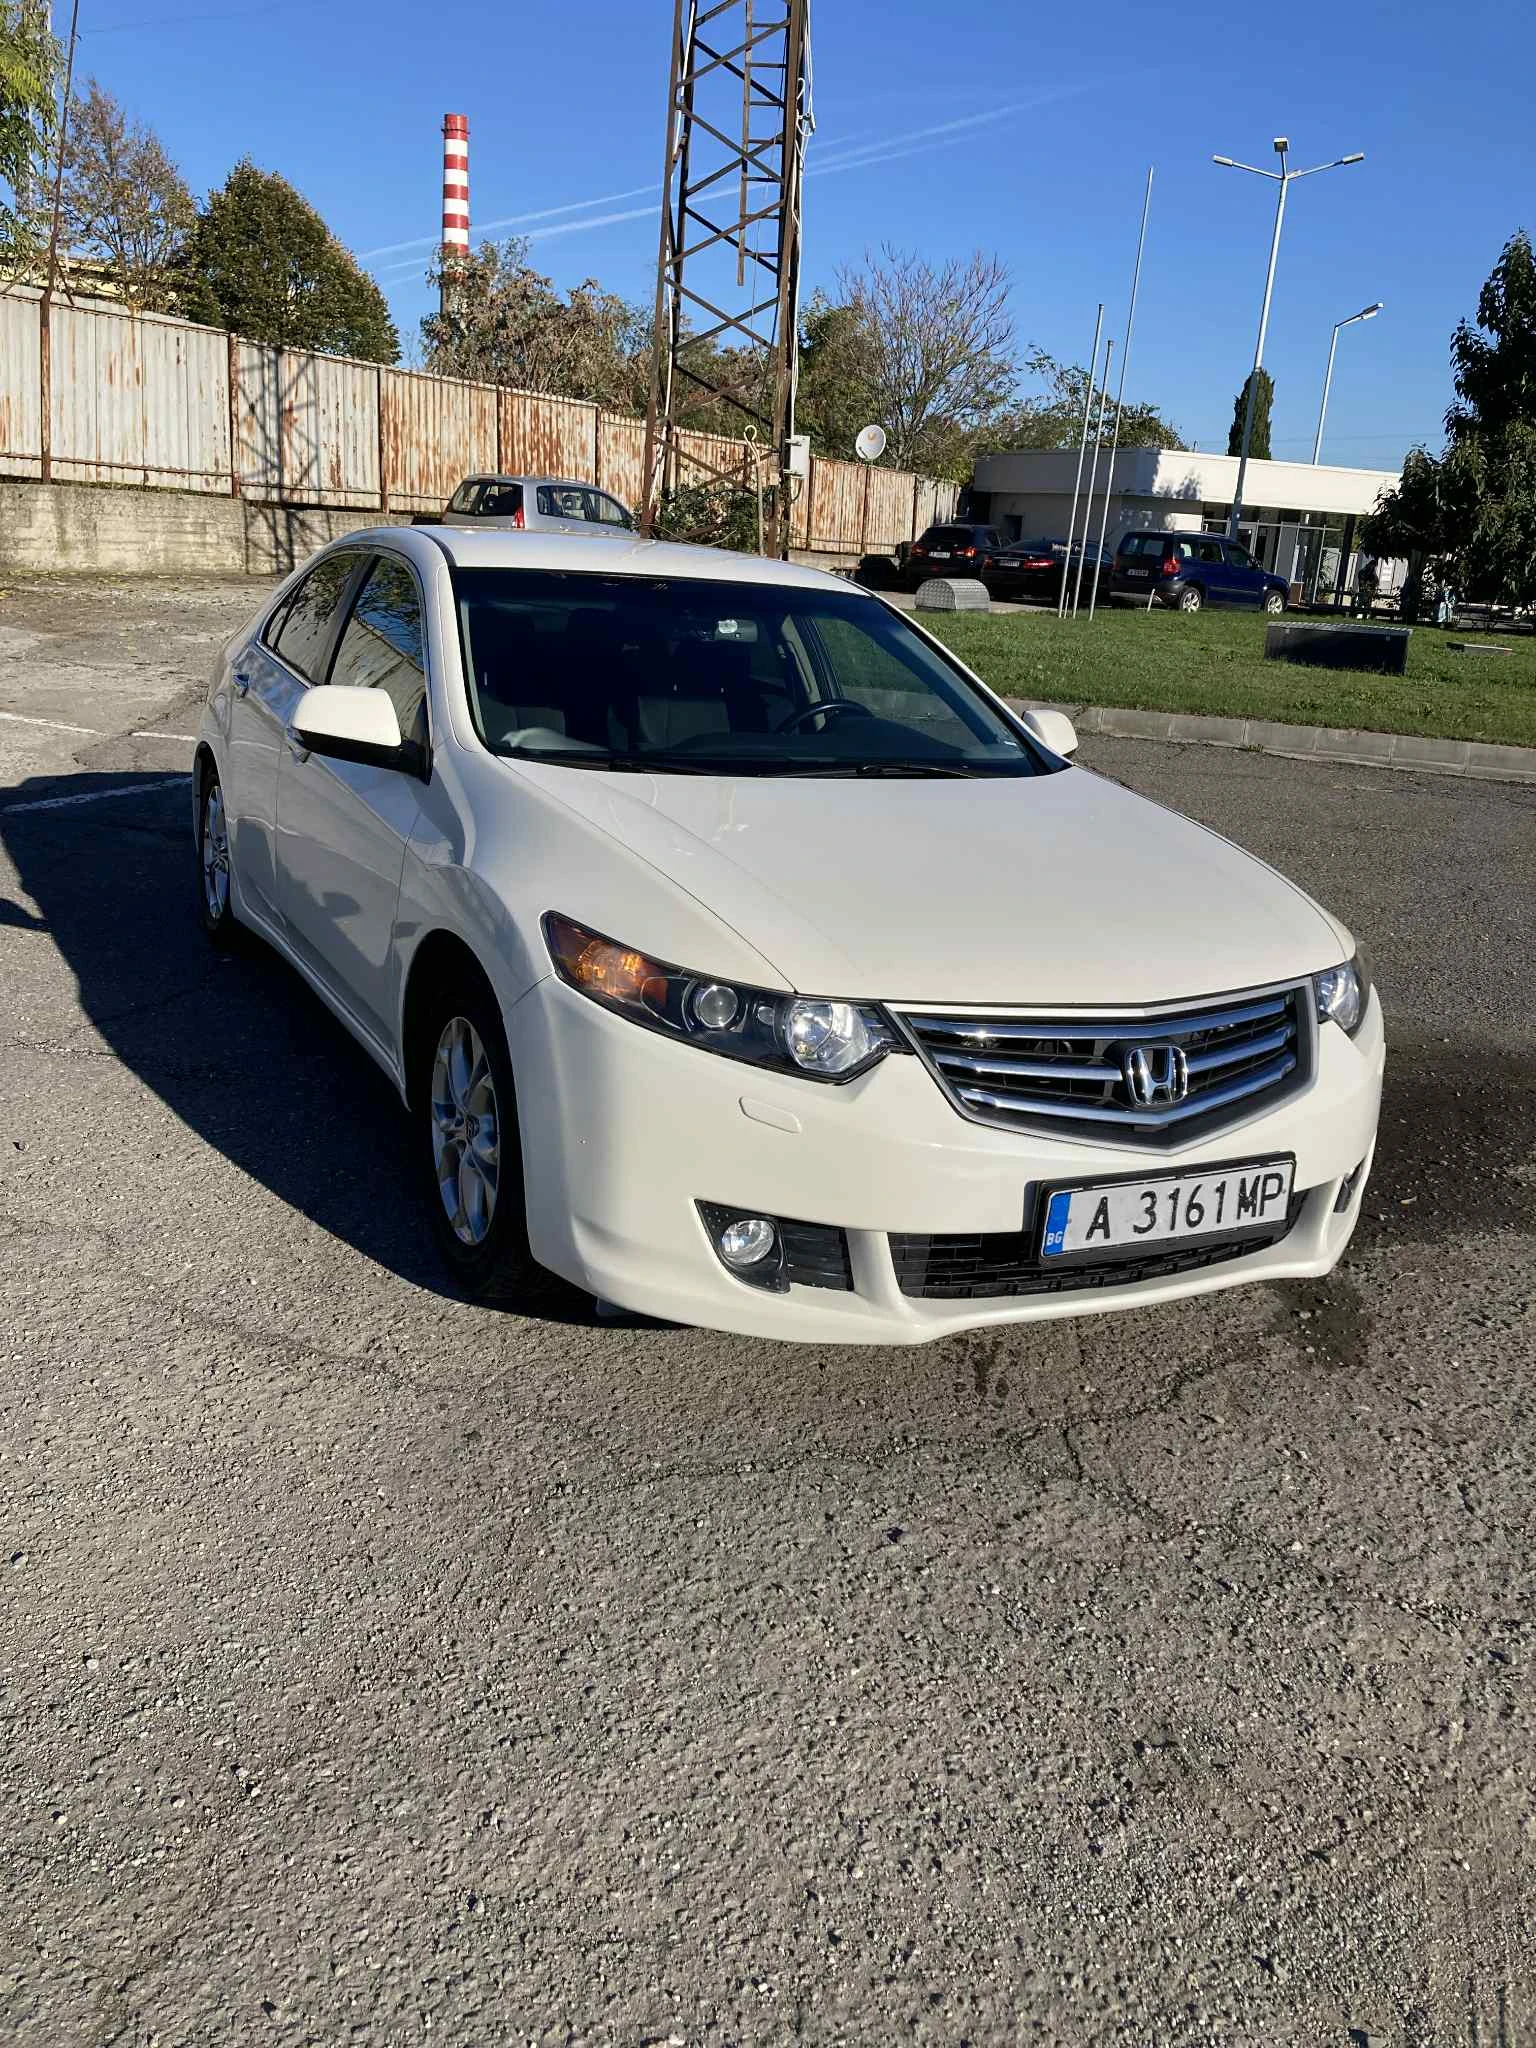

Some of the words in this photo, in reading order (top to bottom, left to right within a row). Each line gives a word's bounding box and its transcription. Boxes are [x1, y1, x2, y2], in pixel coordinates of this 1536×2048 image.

[1085, 1196, 1111, 1240] A
[1132, 1180, 1227, 1234] 3161
[1236, 1172, 1283, 1220] MP
[1047, 1231, 1063, 1245] BG
